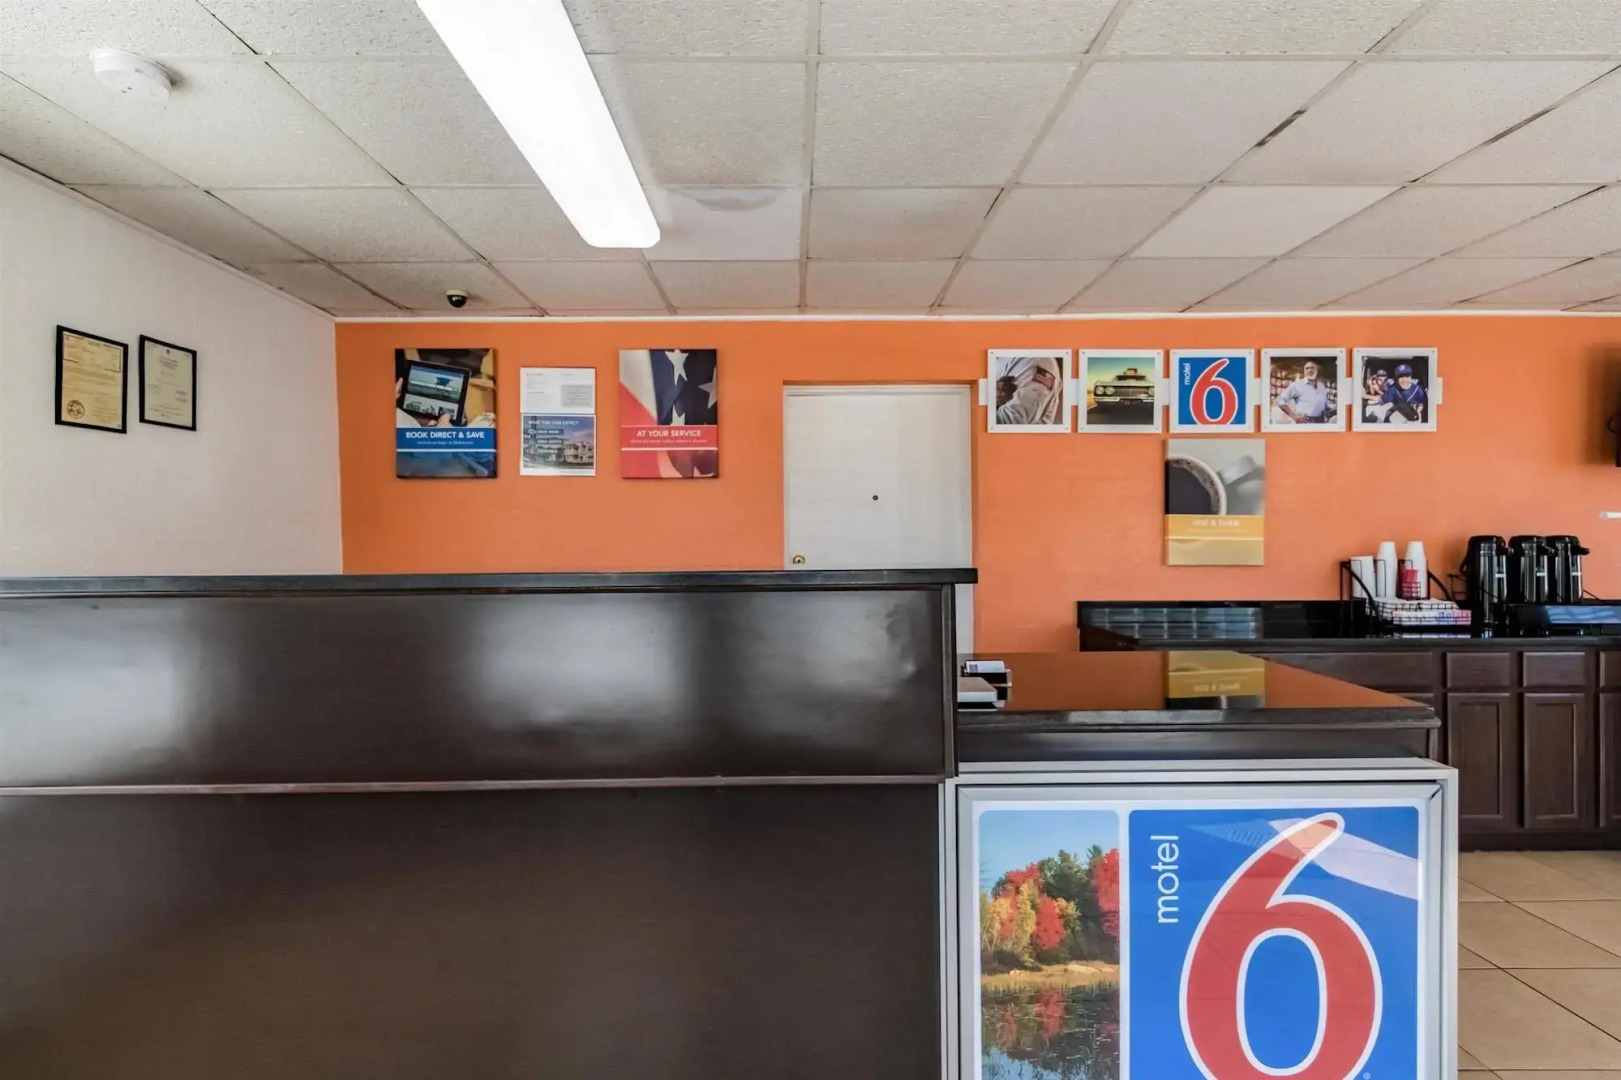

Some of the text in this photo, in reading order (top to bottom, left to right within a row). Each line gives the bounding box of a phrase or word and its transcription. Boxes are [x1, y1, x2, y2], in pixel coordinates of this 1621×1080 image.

[1182, 362, 1191, 386] motel
[1189, 358, 1239, 425] 6
[405, 431, 485, 439] BOOK DIRECT & SAVE
[1150, 835, 1180, 923] motel
[1178, 812, 1383, 1080] 6
